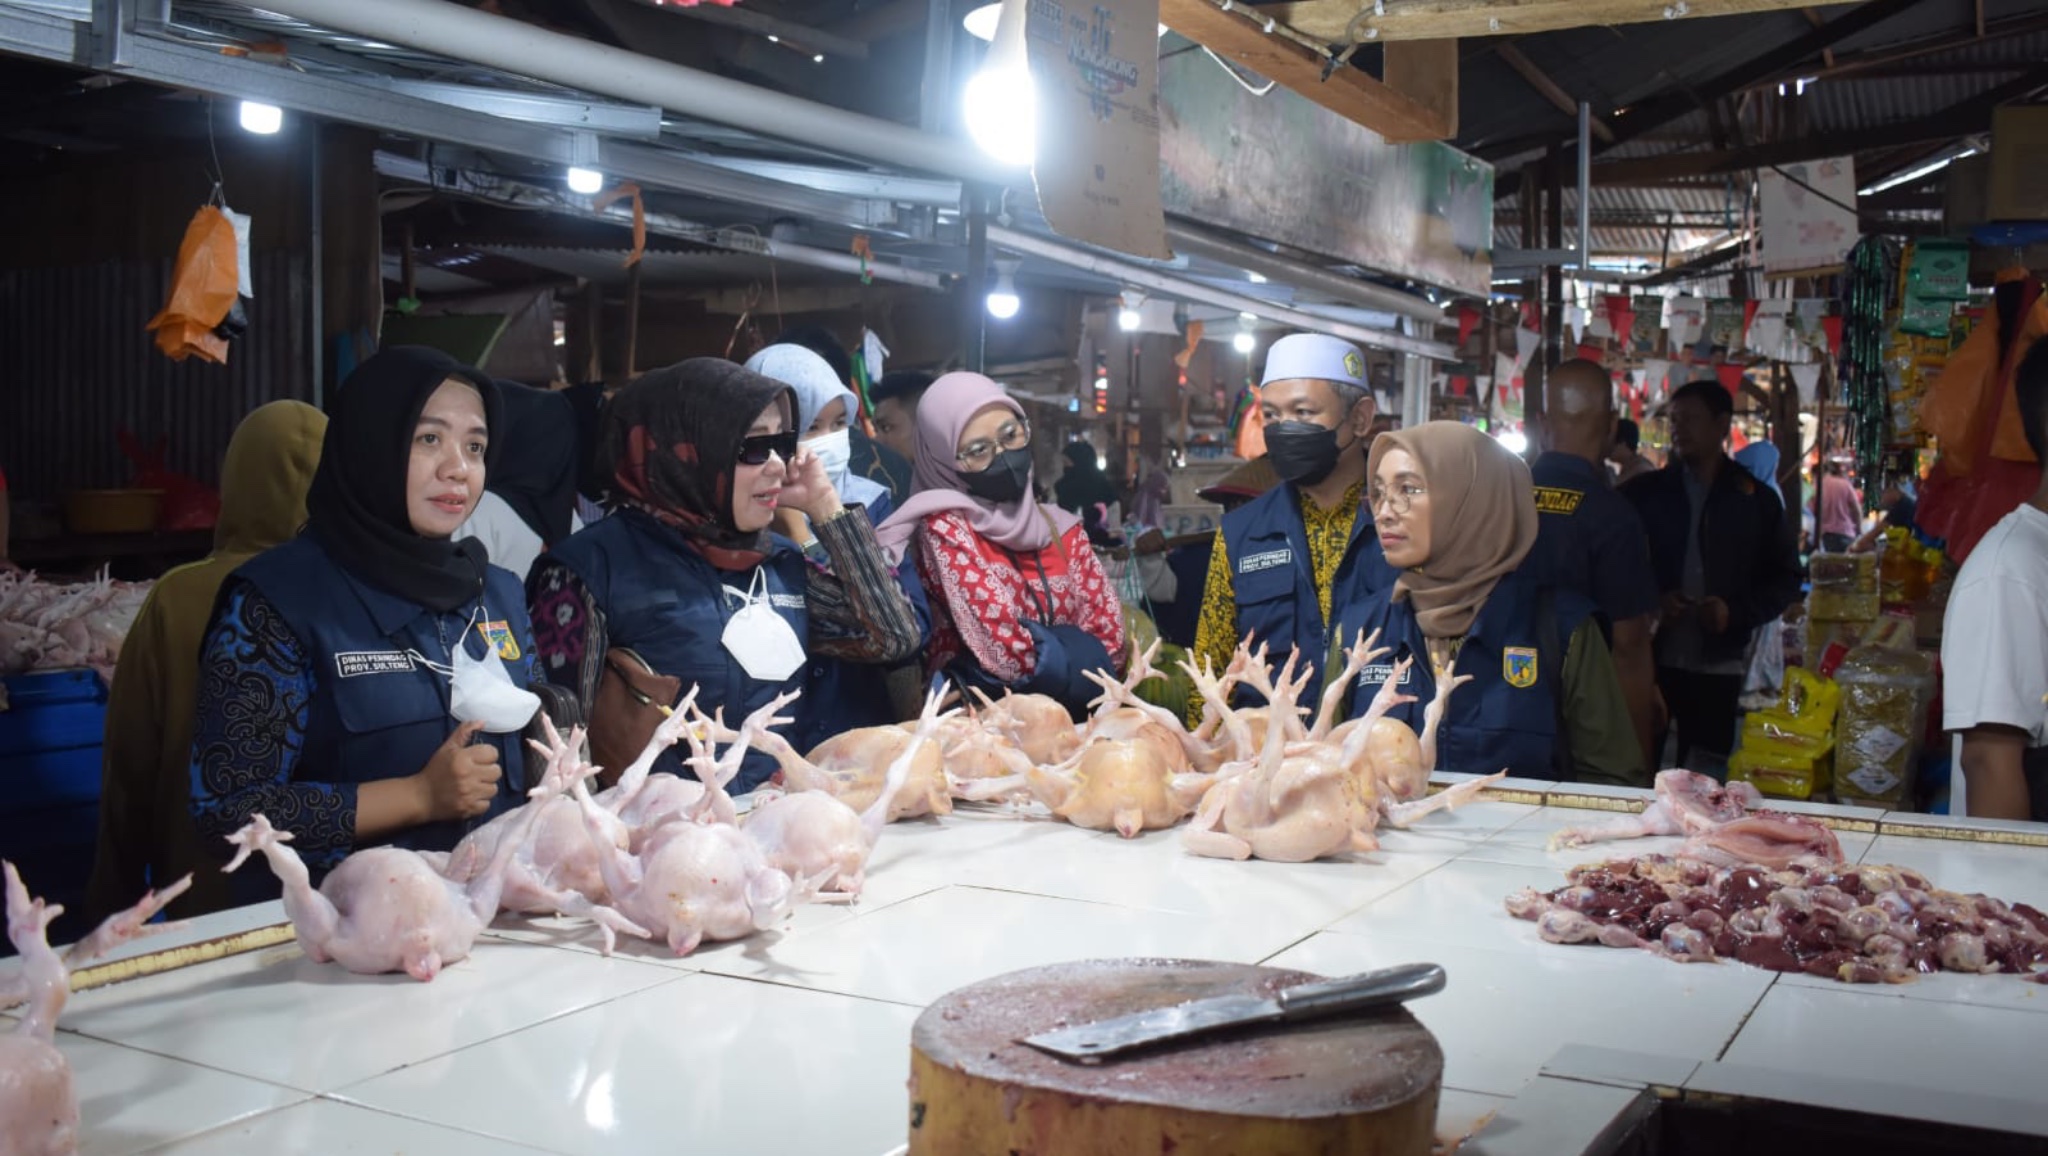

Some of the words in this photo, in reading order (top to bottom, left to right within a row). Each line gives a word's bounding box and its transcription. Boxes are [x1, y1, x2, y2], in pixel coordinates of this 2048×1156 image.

[1533, 490, 1579, 510] INDAG
[342, 655, 366, 665] DINAS
[344, 663, 372, 674] PROV.
[373, 662, 410, 670] SULTENG
